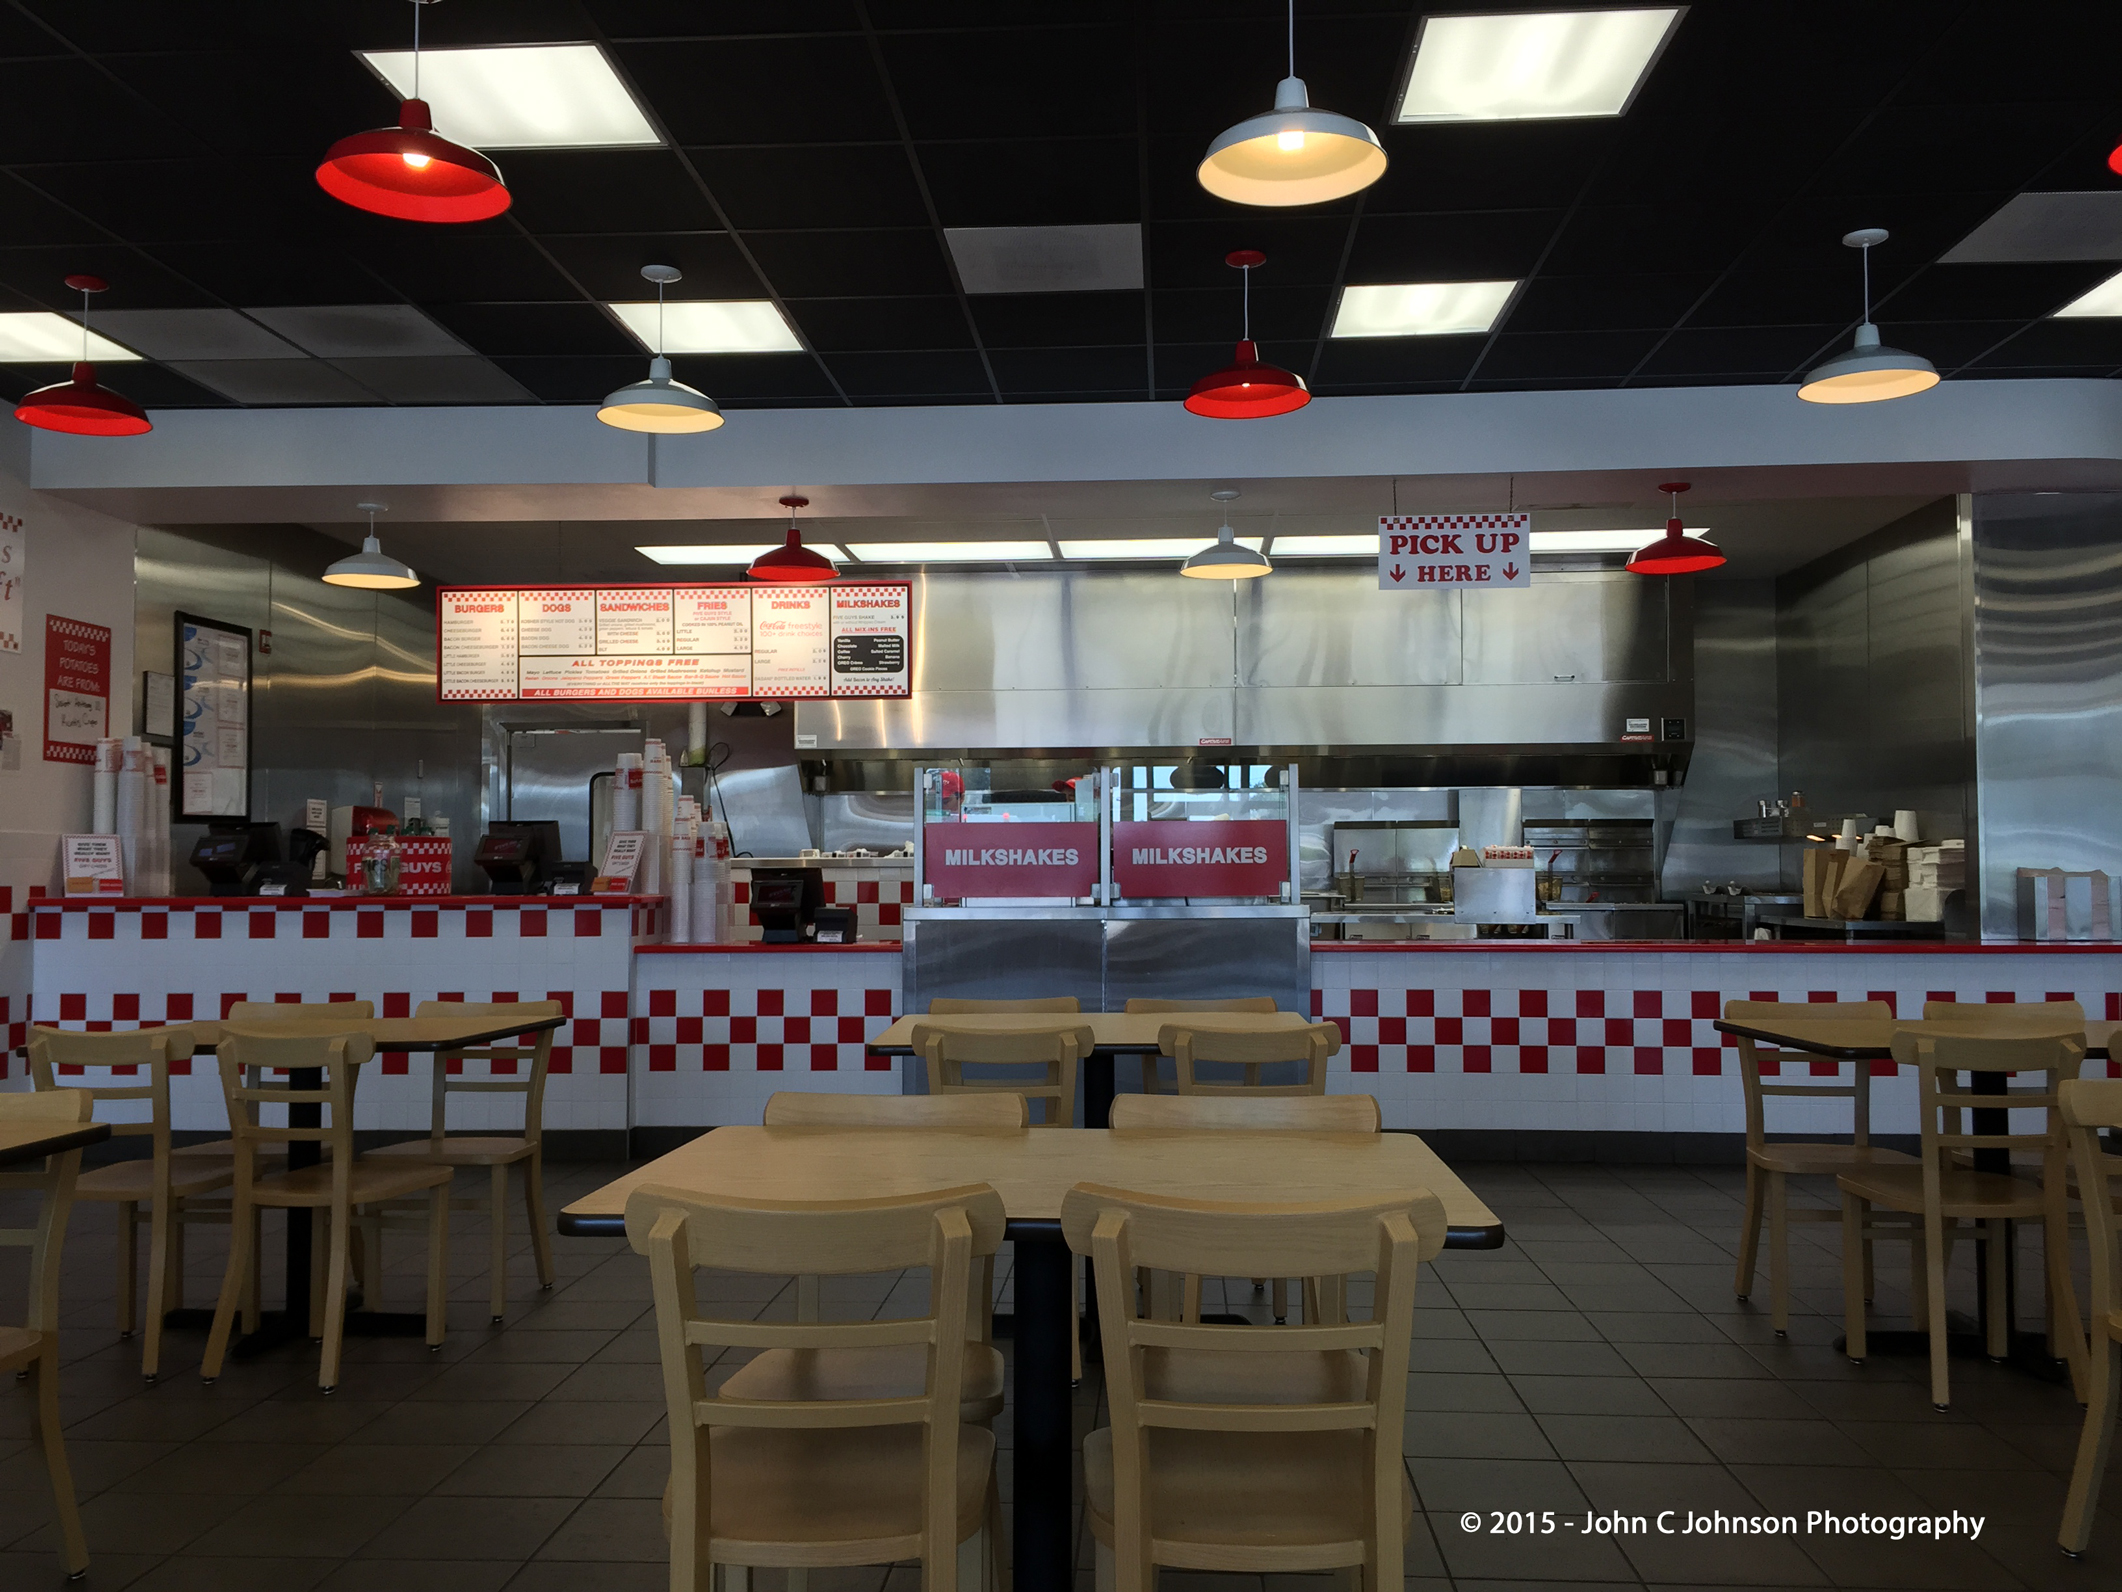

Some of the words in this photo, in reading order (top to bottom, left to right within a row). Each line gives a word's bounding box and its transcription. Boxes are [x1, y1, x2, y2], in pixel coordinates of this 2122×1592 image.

[1389, 534, 1464, 555] PICK
[1475, 533, 1520, 554] UP
[1417, 564, 1491, 582] HERE
[454, 604, 505, 613] BURGERS
[542, 603, 572, 613] DOGS
[600, 602, 670, 612] SANDWICHES
[697, 601, 728, 610] FRIES
[771, 600, 811, 610] DRINKS
[836, 599, 901, 608] MILKSHAKES
[759, 620, 786, 630] Coca-Cola
[788, 621, 823, 631] freestyle
[63, 640, 97, 657] TODAY'S
[59, 657, 99, 675] POTATOES
[599, 659, 663, 667] TOPPINGS
[667, 658, 700, 666] FREE
[57, 675, 74, 689] ARE
[75, 677, 101, 692] FROM:
[533, 689, 551, 697] ALL
[597, 688, 618, 696] AND
[645, 687, 695, 695] AVAILABLE
[695, 687, 738, 695] BUNLESS
[945, 848, 1079, 866] MILKSHAKES
[1132, 846, 1267, 865] MILKSHAKES
[399, 861, 442, 874] GUYS
